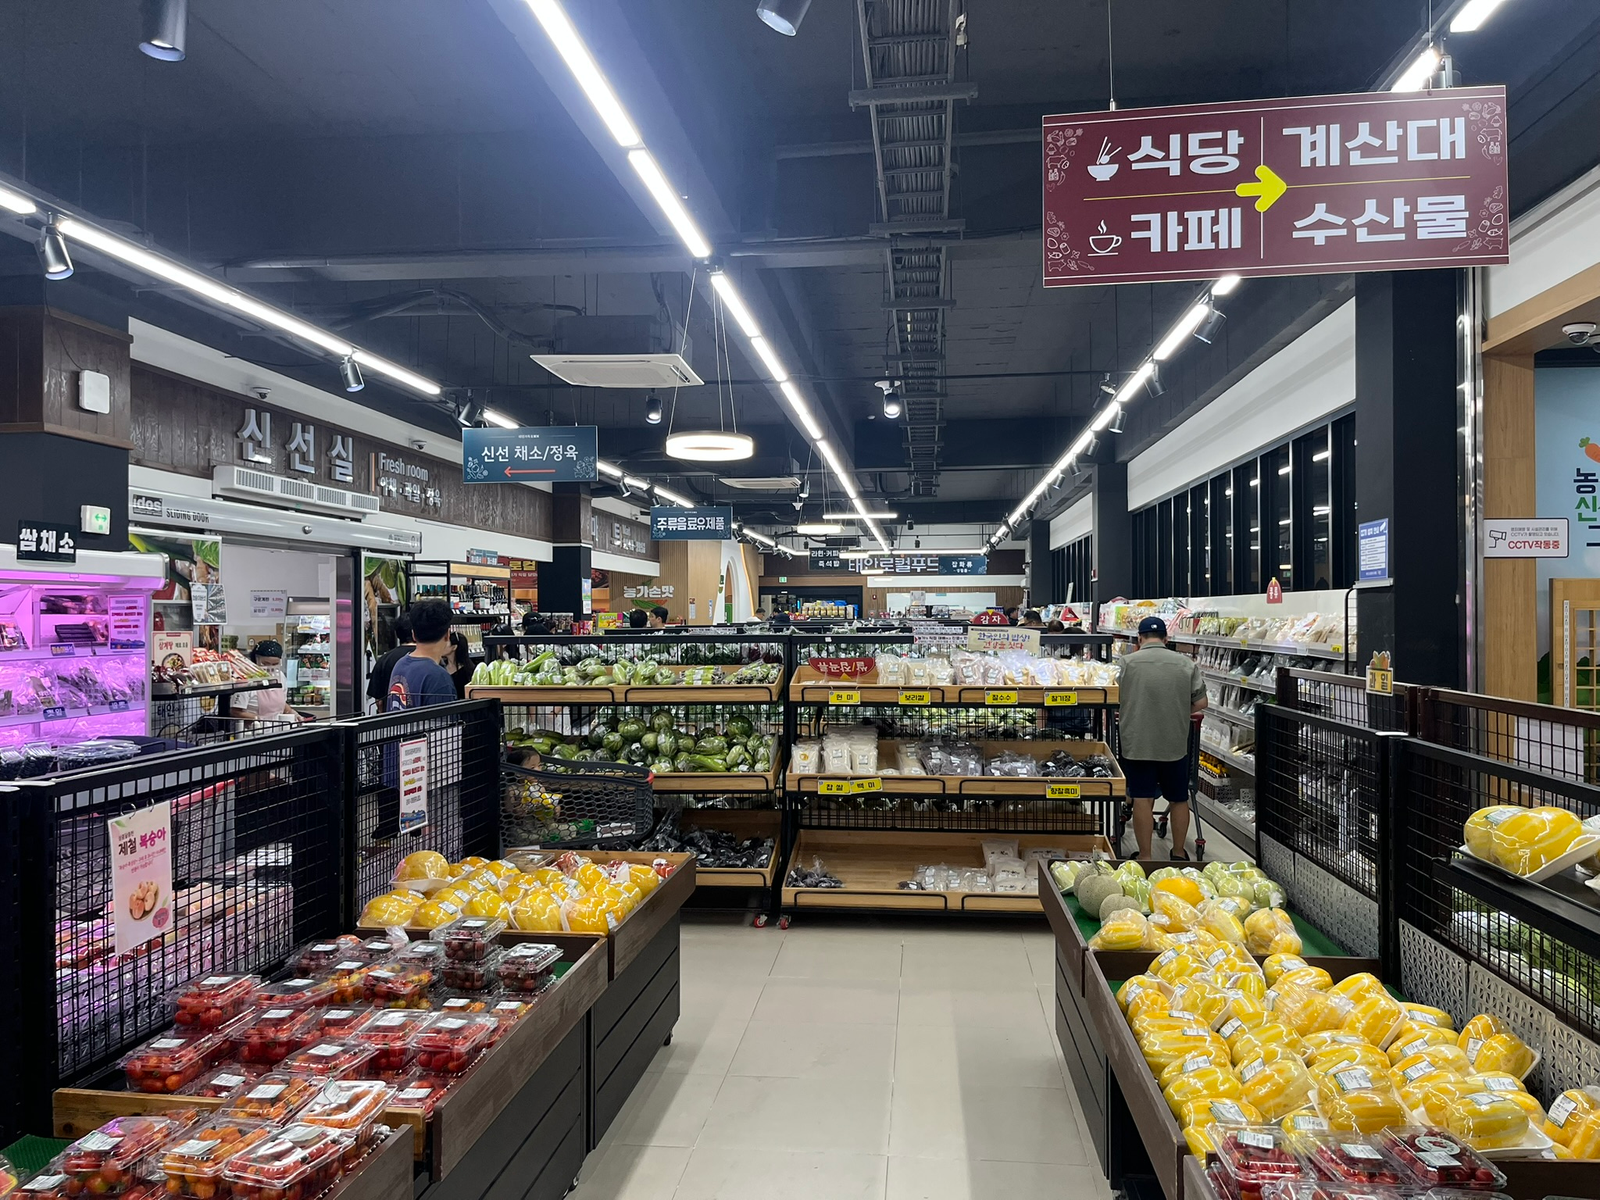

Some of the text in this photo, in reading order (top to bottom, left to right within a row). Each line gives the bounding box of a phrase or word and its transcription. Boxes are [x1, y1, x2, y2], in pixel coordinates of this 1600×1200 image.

[1126, 129, 1245, 177] 식당
[1282, 116, 1466, 168] 계산대
[1130, 206, 1242, 253] 카페
[1292, 194, 1470, 246] 수산물
[378, 452, 429, 482] Fresh room
[481, 444, 579, 463] 신선 채소/정육
[166, 508, 192, 521] SLIDING
[193, 511, 210, 523] DOOR
[1575, 495, 1600, 522] 신
[656, 516, 725, 532] 주류음료유제품
[19, 528, 75, 555] 쌈채소
[1507, 540, 1560, 550] CCTV작동중
[623, 585, 675, 598] 농가손맛
[977, 632, 1009, 642] 한국인의
[118, 837, 137, 856] 제철
[139, 826, 167, 849] 복숭아
